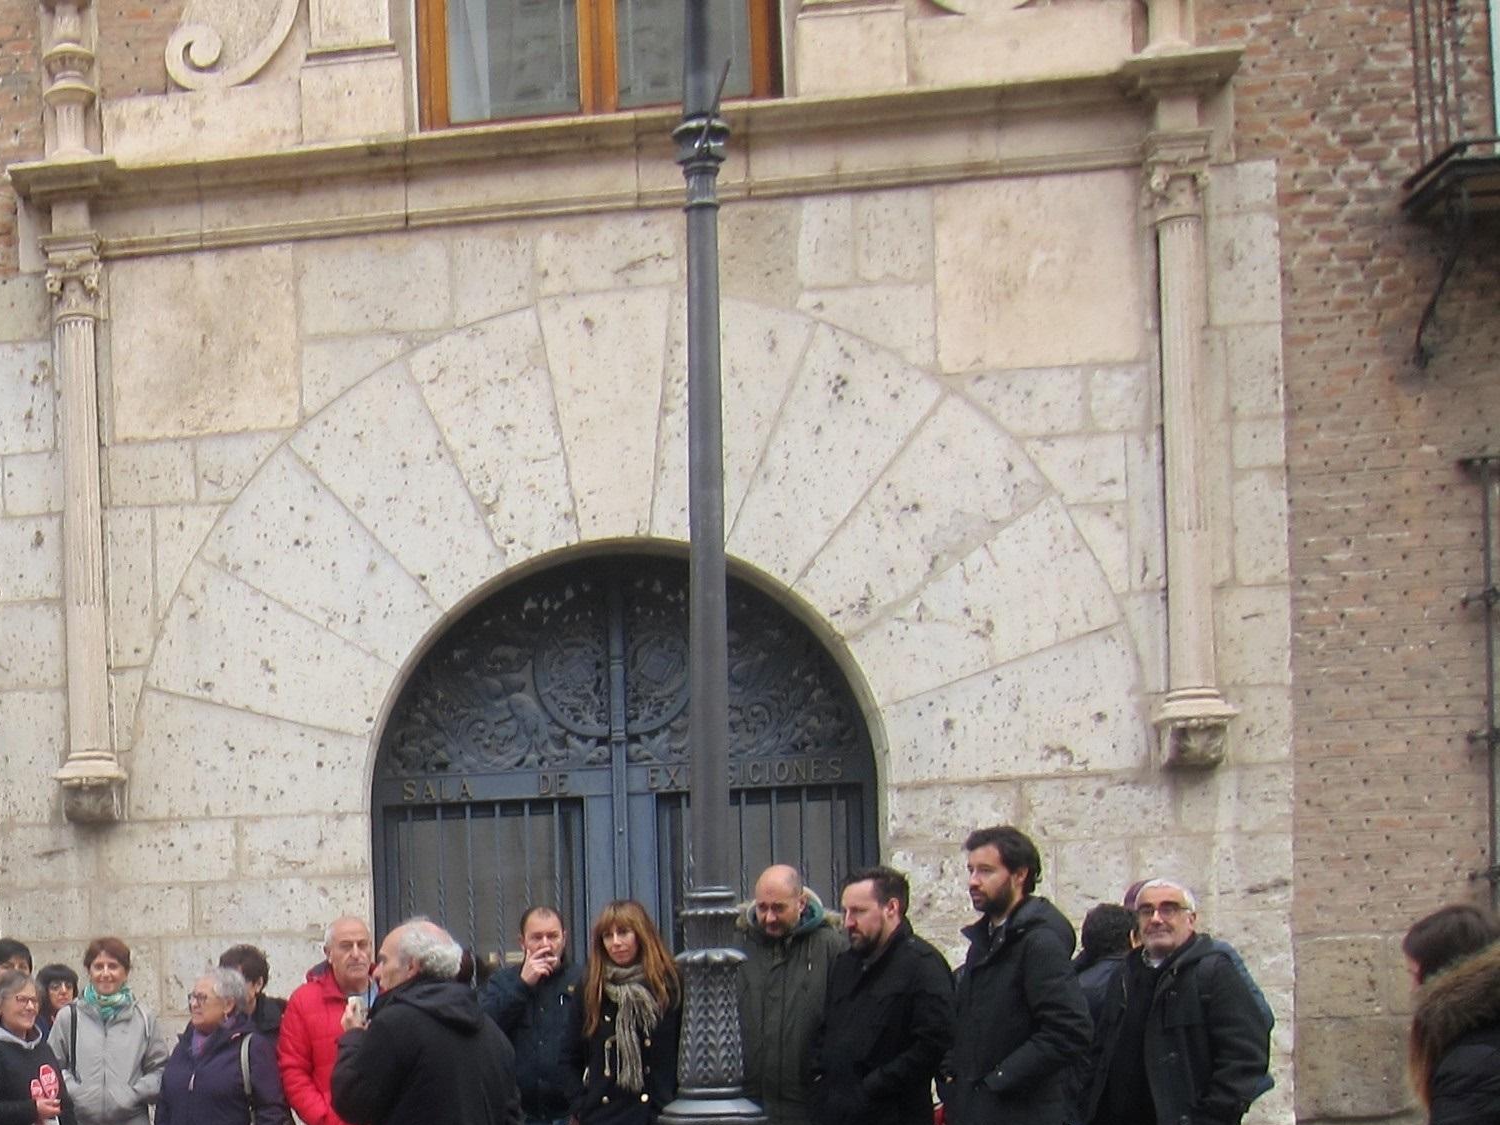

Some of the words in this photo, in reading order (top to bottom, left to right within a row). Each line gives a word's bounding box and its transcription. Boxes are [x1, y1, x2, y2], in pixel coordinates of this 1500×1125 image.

[402, 777, 472, 801] SALA
[539, 772, 569, 795] DE
[648, 757, 843, 790] EXSICIONES
